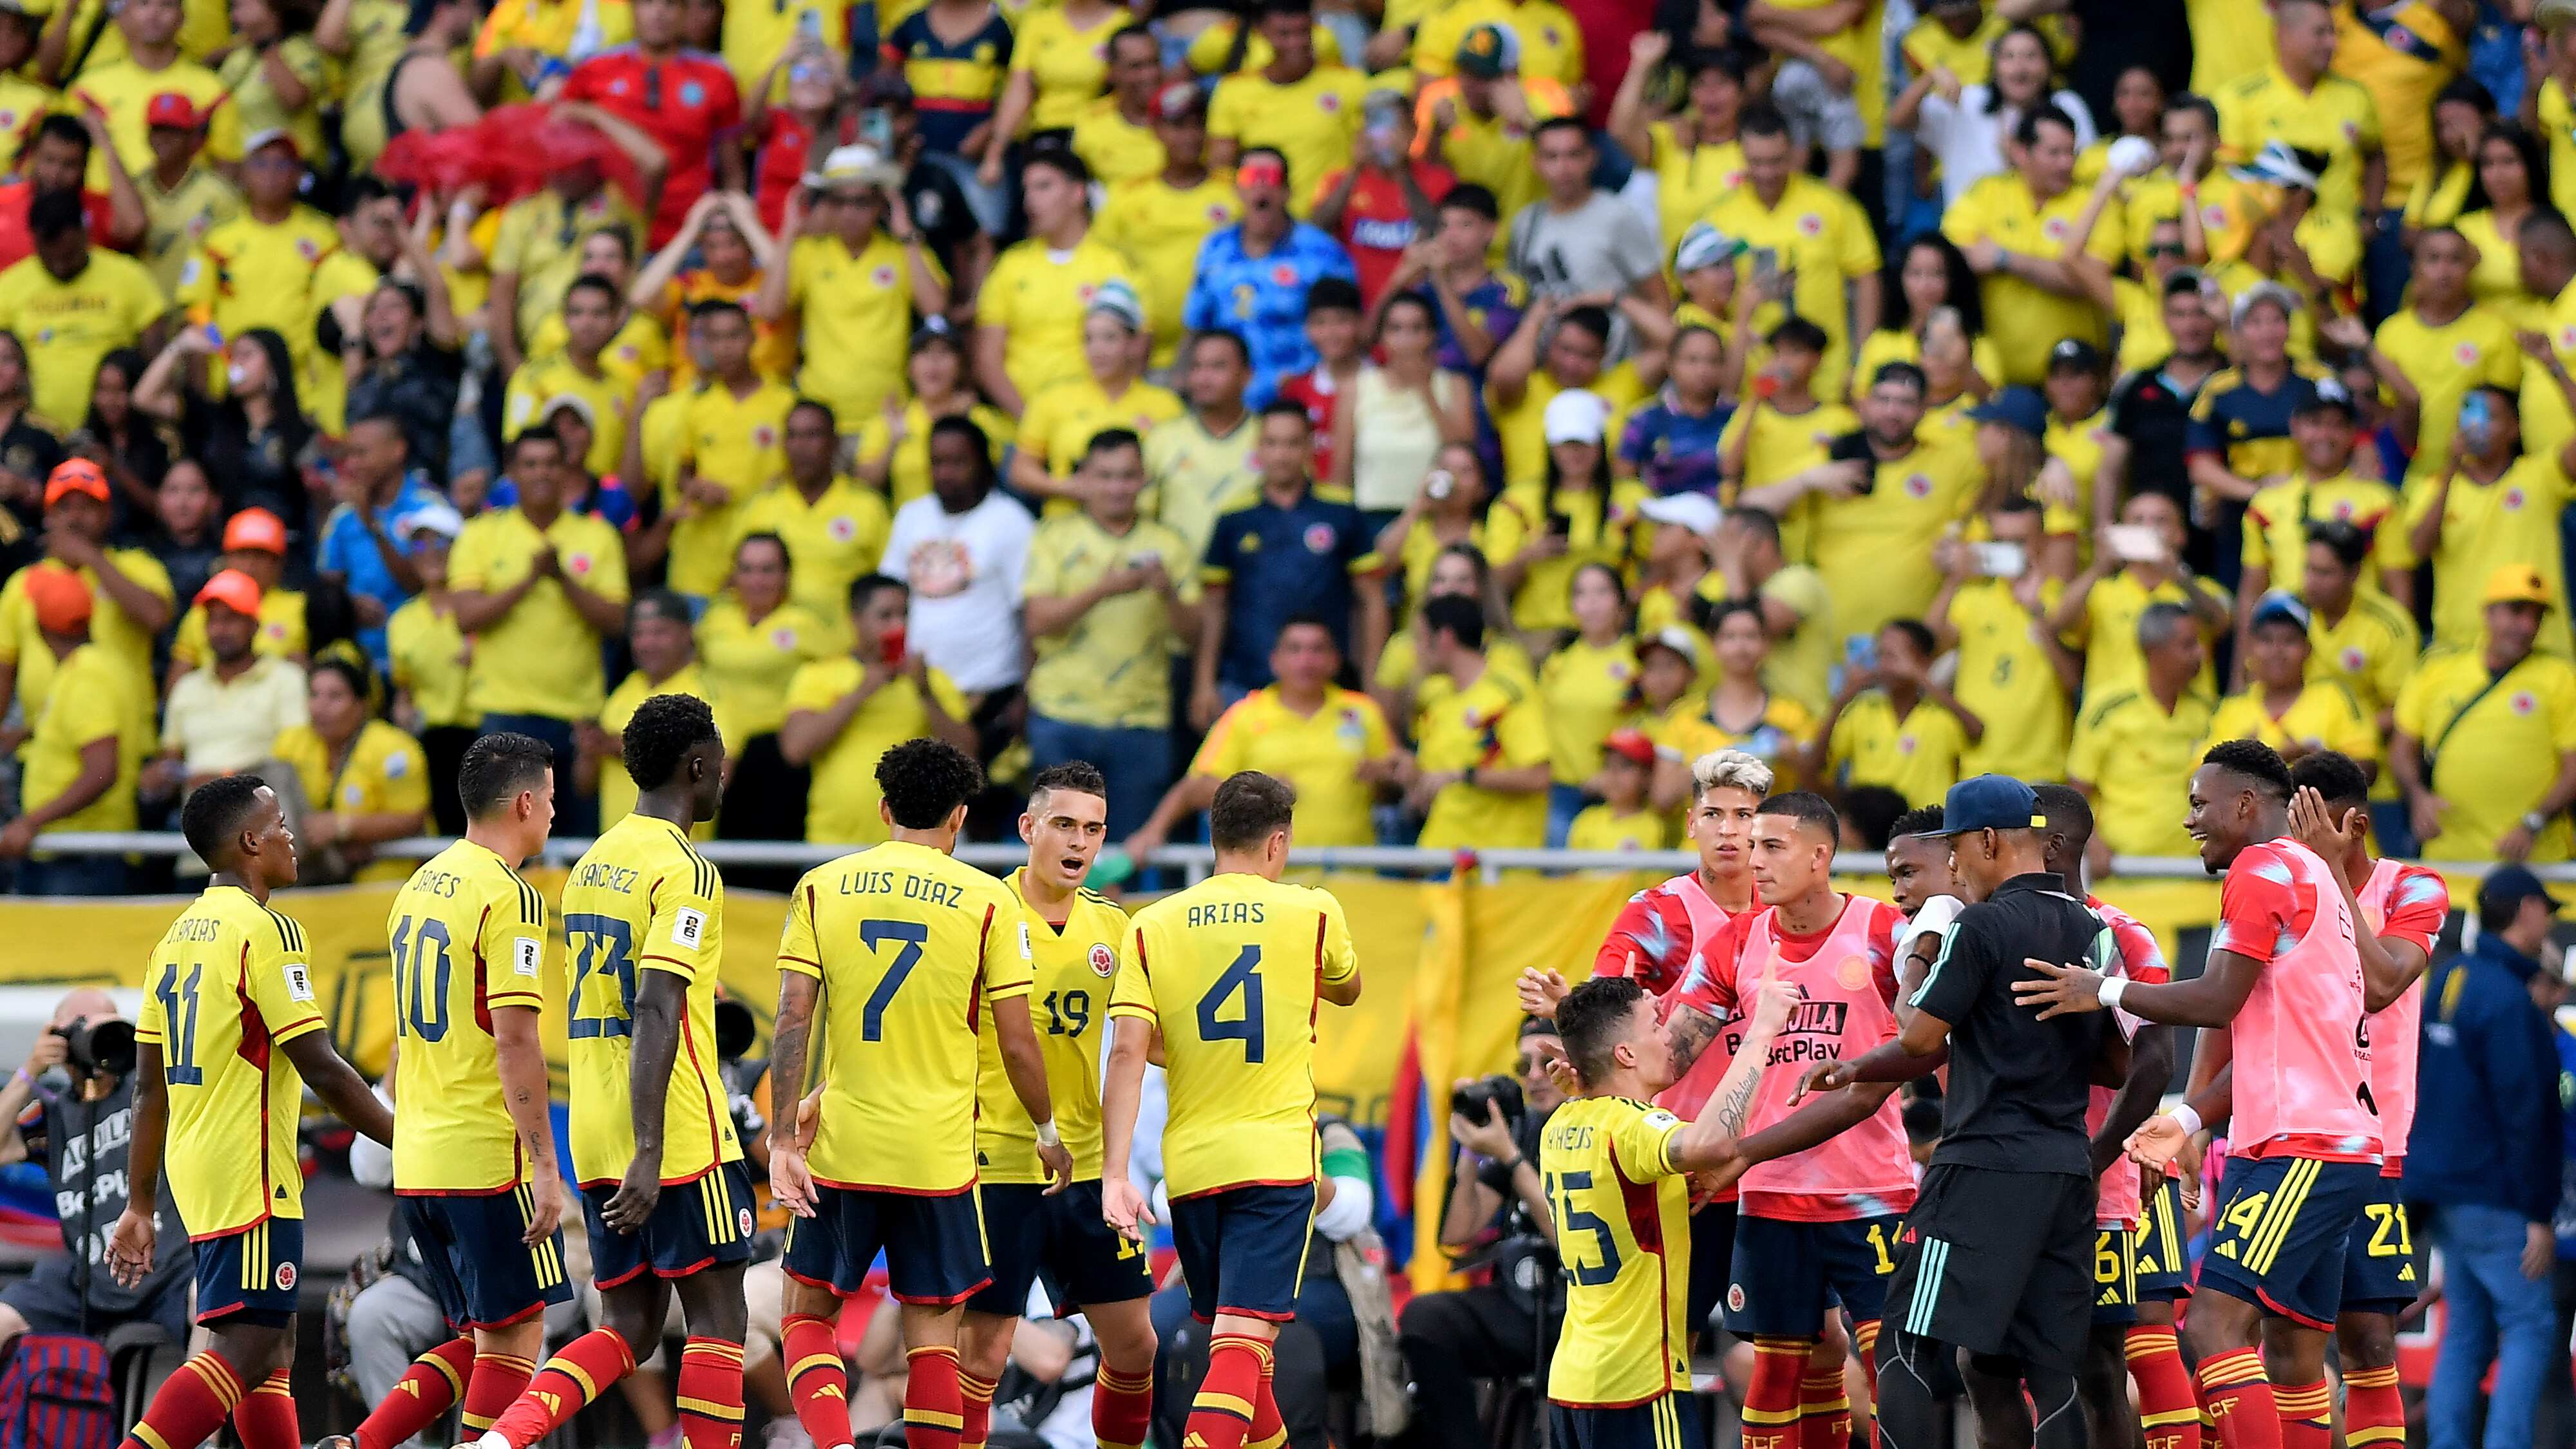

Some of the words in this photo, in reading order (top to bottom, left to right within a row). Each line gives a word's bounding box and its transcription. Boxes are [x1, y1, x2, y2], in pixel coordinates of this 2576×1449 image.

[413, 869, 461, 898] JAMES
[840, 871, 894, 895] LUIS
[904, 873, 963, 909] DÍAZ
[167, 918, 220, 945] J.ARIAS
[1188, 902, 1264, 928] ARIAS
[392, 915, 451, 1042] 10
[564, 913, 636, 1039] 23
[860, 919, 928, 1041] 7
[155, 963, 203, 1085] 11
[1043, 990, 1090, 1037] 19
[1196, 944, 1264, 1063] 4
[1546, 1171, 1622, 1287] 15
[2364, 1203, 2413, 1256] 21
[2209, 1396, 2239, 1418] CF
[1741, 1434, 1784, 1449] FCF
